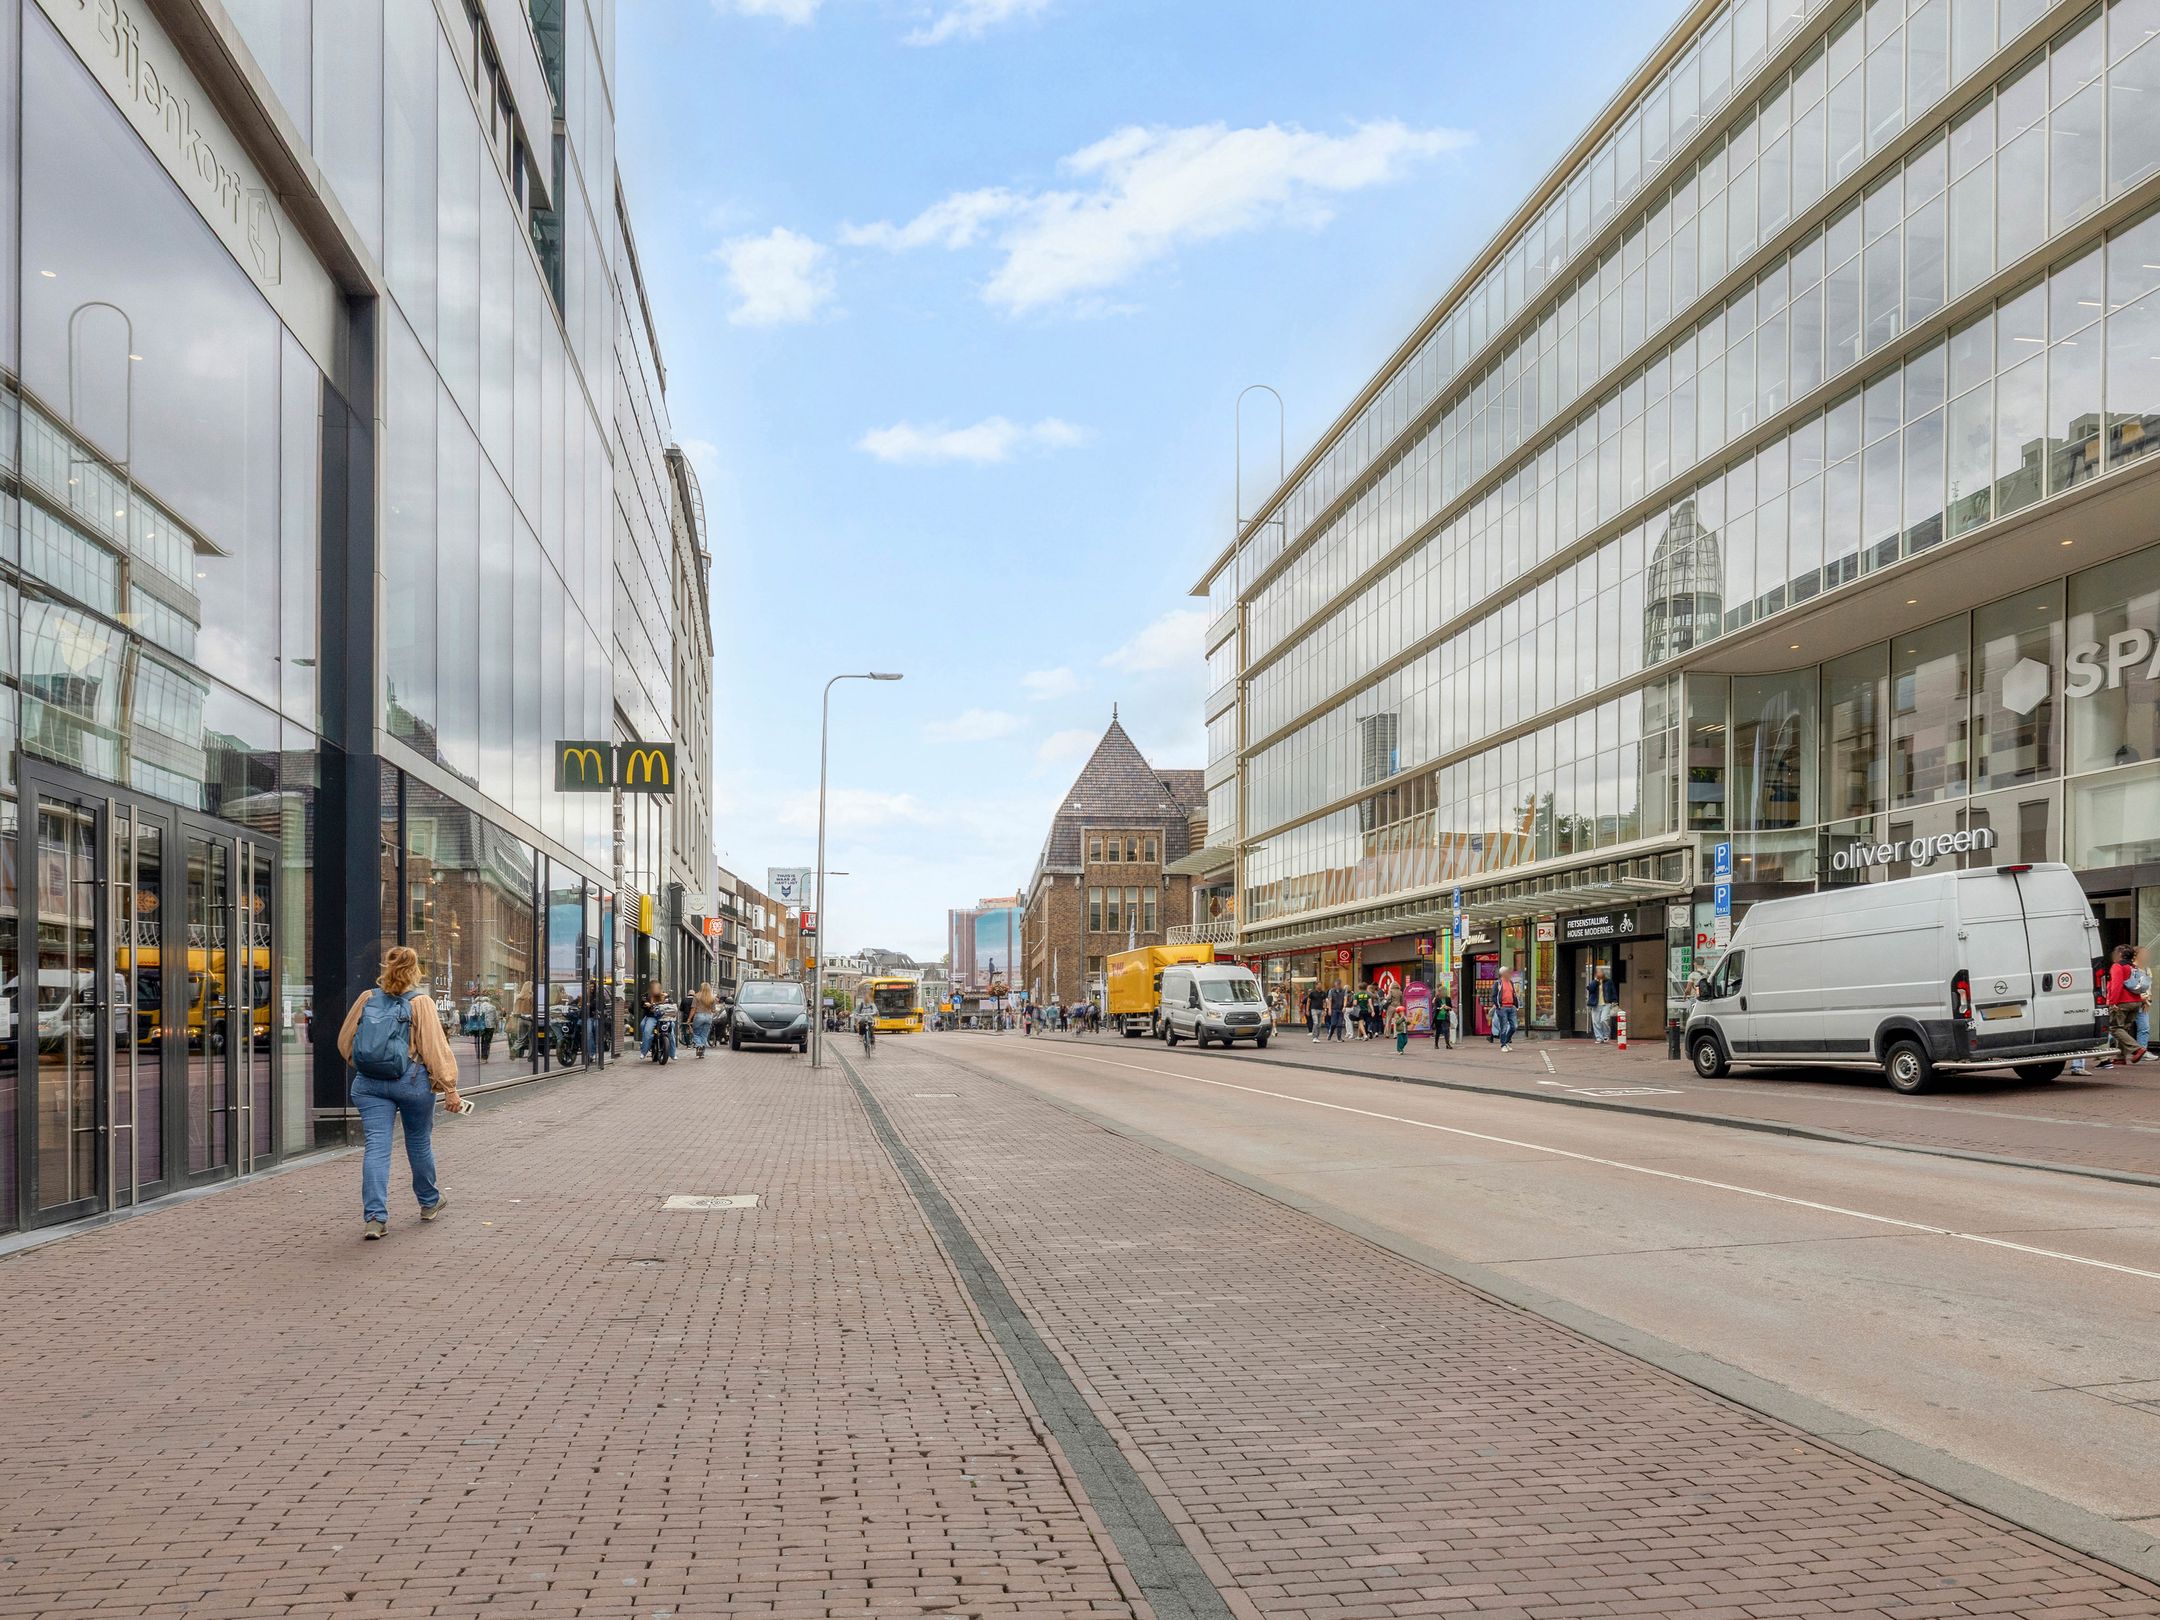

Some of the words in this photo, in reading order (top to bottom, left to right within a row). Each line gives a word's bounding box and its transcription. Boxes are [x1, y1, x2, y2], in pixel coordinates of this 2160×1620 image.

[1717, 846, 1727, 863] P
[1833, 840, 1906, 871] oliver
[1909, 827, 1991, 868] green
[1717, 888, 1727, 904] P
[1567, 916, 1609, 929] FIETSENSTALLING
[1567, 928, 1584, 938] HOUSE
[1584, 925, 1614, 936] MODERNES
